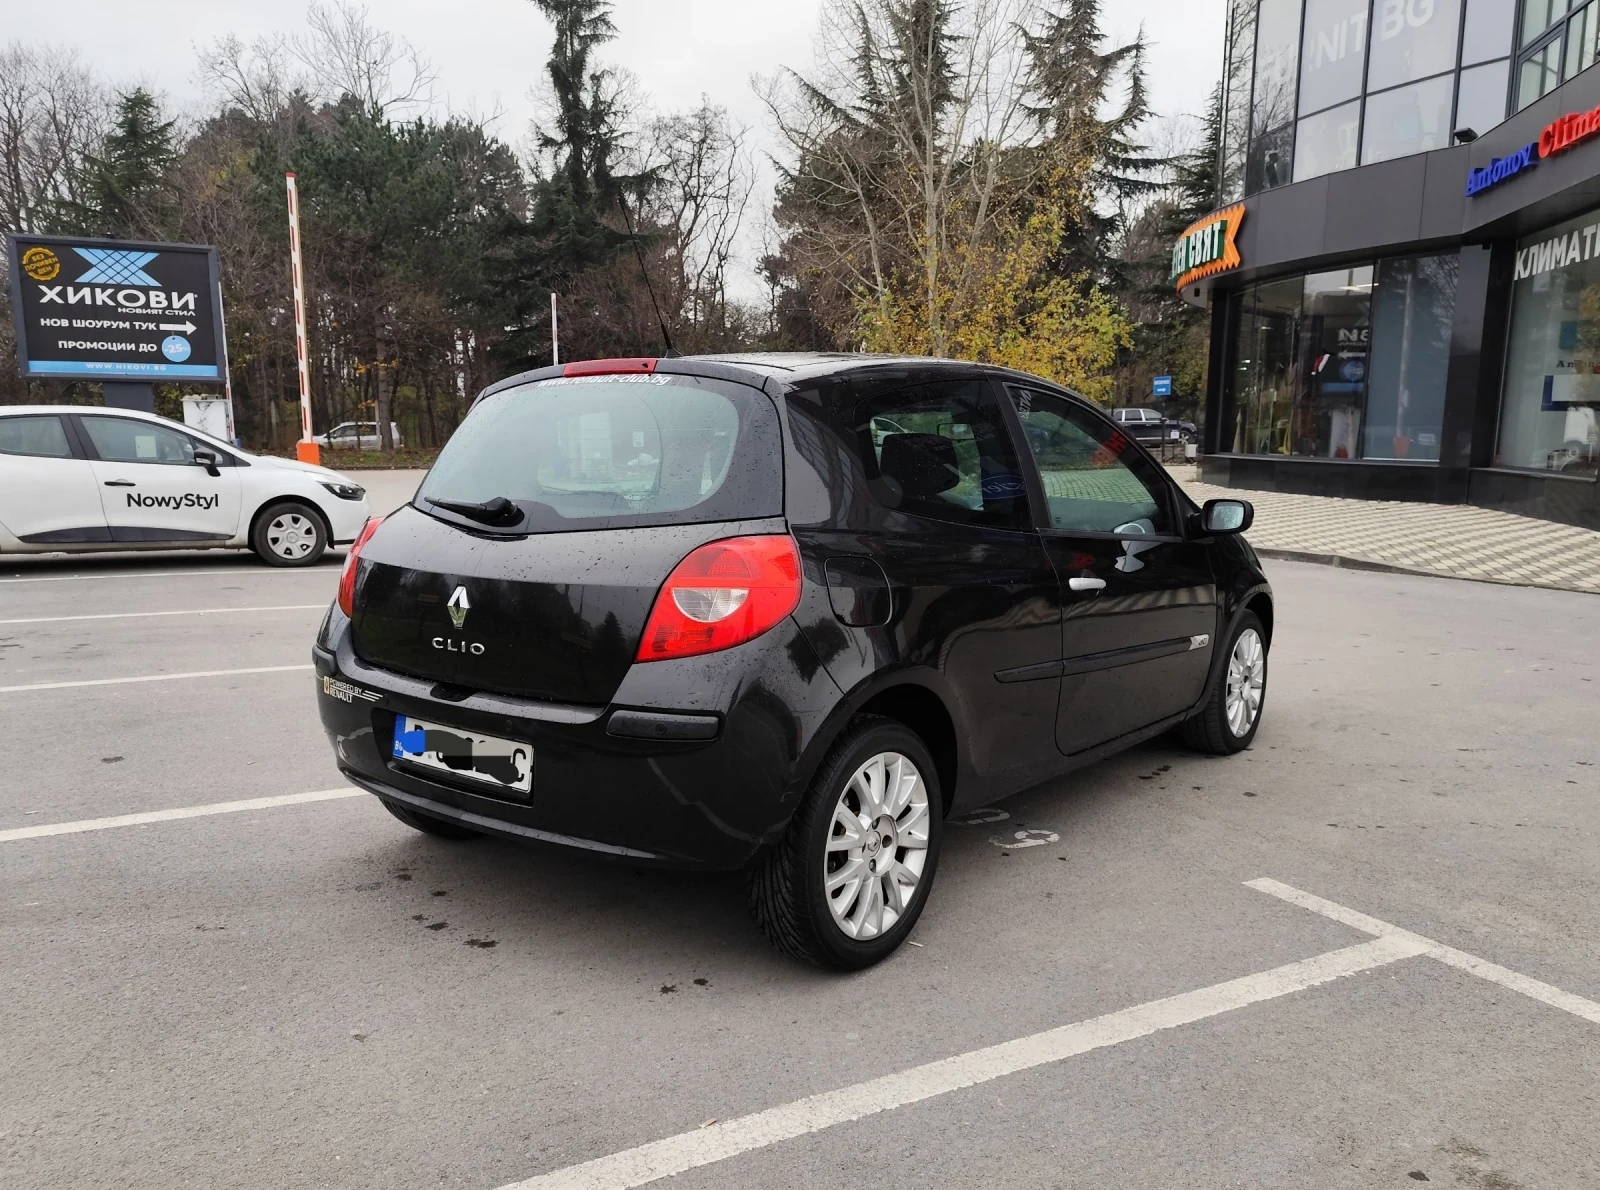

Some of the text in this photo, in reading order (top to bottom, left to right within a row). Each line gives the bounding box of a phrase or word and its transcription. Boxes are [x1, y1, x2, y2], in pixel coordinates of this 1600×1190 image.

[1380, 0, 1434, 42] BG
[1465, 143, 1536, 197] Antonov
[1189, 222, 1221, 268] СВЯТ
[25, 256, 58, 271] ПОЧИВЕН
[32, 254, 45, 262] БЕЗ
[37, 265, 52, 275] ДЕН
[37, 285, 196, 310] ХИКОВИ
[117, 307, 196, 317] НОВИЯТ СТИЛ
[40, 318, 158, 331] НОВ ШОУРУМ ТУК
[58, 340, 136, 352] ПРОМОЦИИ
[138, 343, 158, 353] ДО
[85, 362, 167, 371] WWW.HIKOVI.BG
[126, 492, 219, 510] NowyStyl
[431, 636, 486, 656] CLIO
[329, 677, 363, 695] POWERED BY
[329, 687, 354, 704] RENAULT
